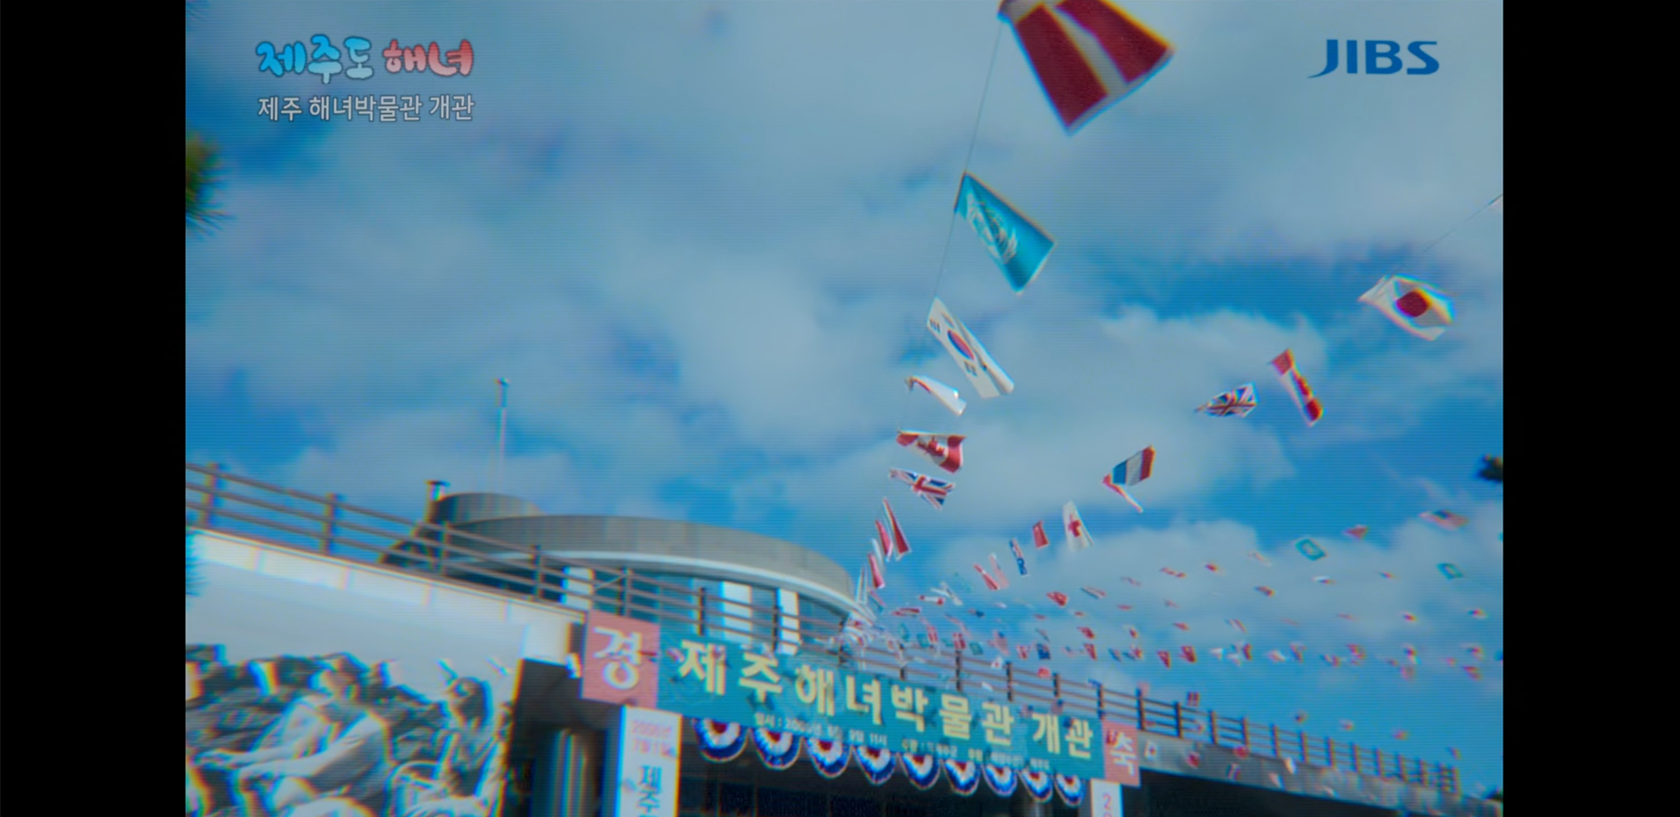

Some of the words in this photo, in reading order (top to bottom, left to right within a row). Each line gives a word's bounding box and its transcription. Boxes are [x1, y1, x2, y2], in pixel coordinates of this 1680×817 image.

[592, 626, 643, 690] 경
[677, 639, 1015, 746] 제주해녀박물관
[1031, 711, 1094, 760] 개관
[637, 765, 663, 817] 제주
